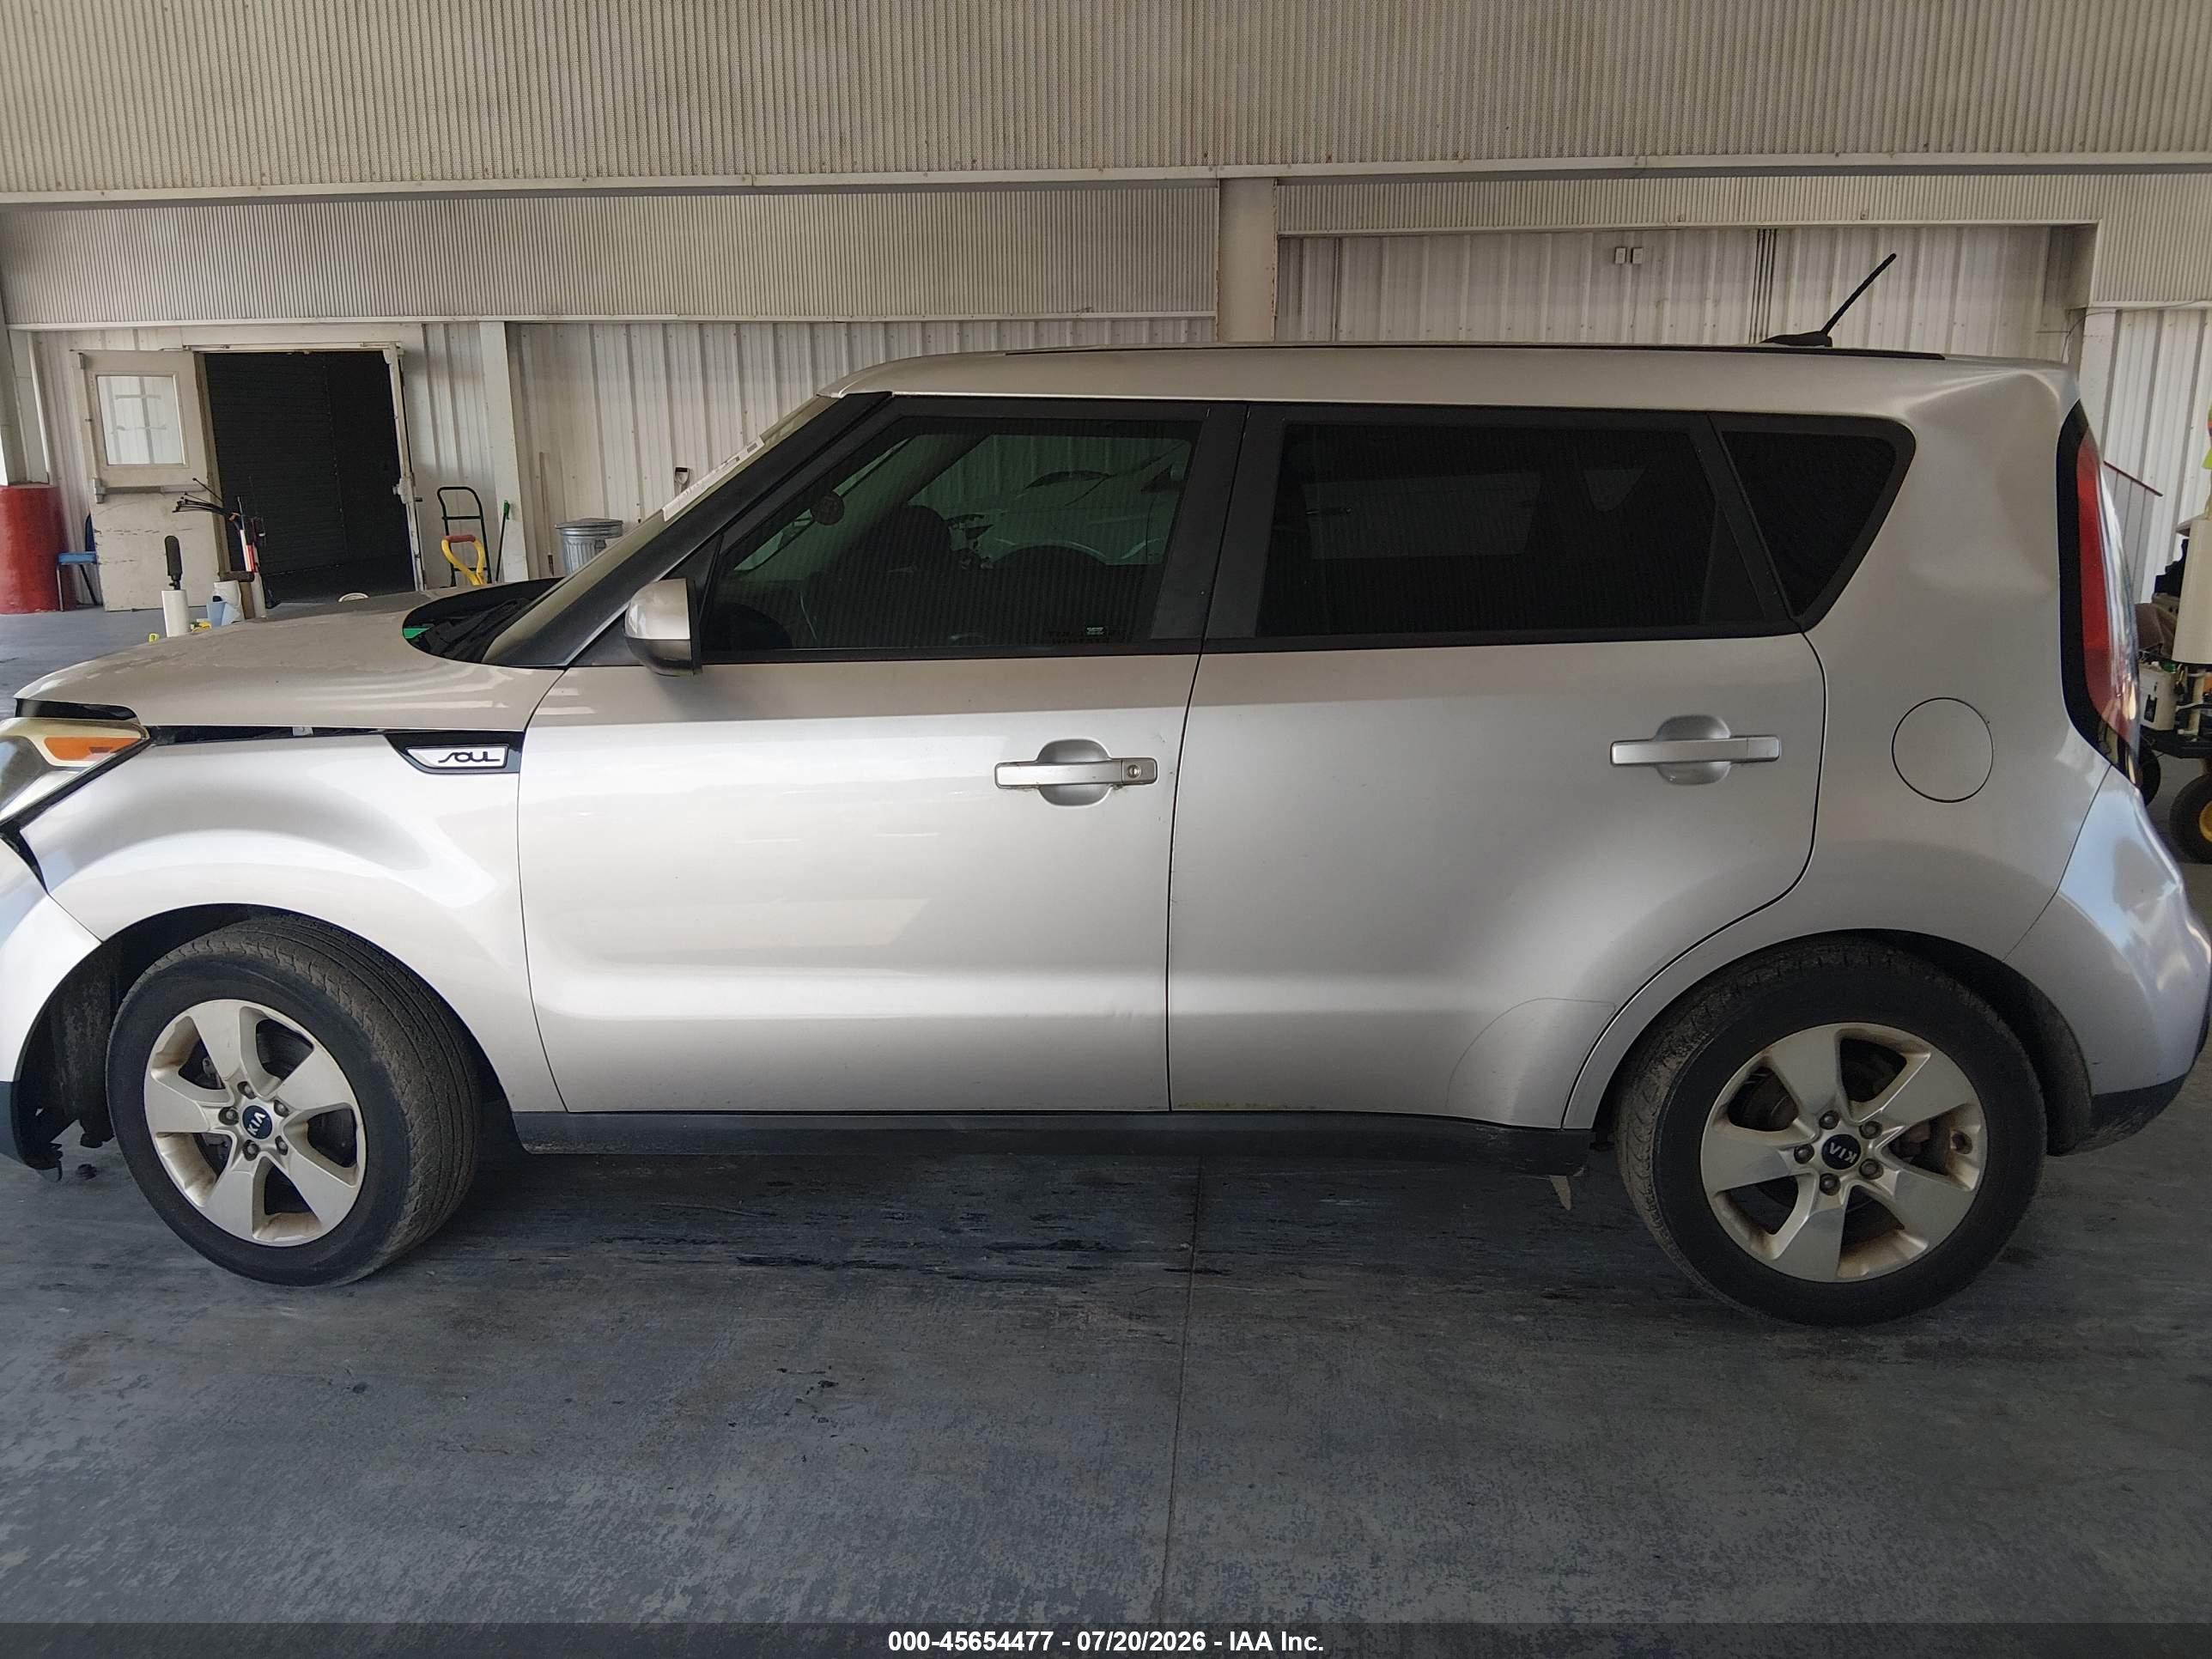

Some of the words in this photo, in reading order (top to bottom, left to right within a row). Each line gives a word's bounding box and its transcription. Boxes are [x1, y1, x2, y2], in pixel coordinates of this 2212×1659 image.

[438, 750, 501, 763] SOUL
[246, 1112, 266, 1135] KIA
[1829, 1142, 1857, 1164] KIA
